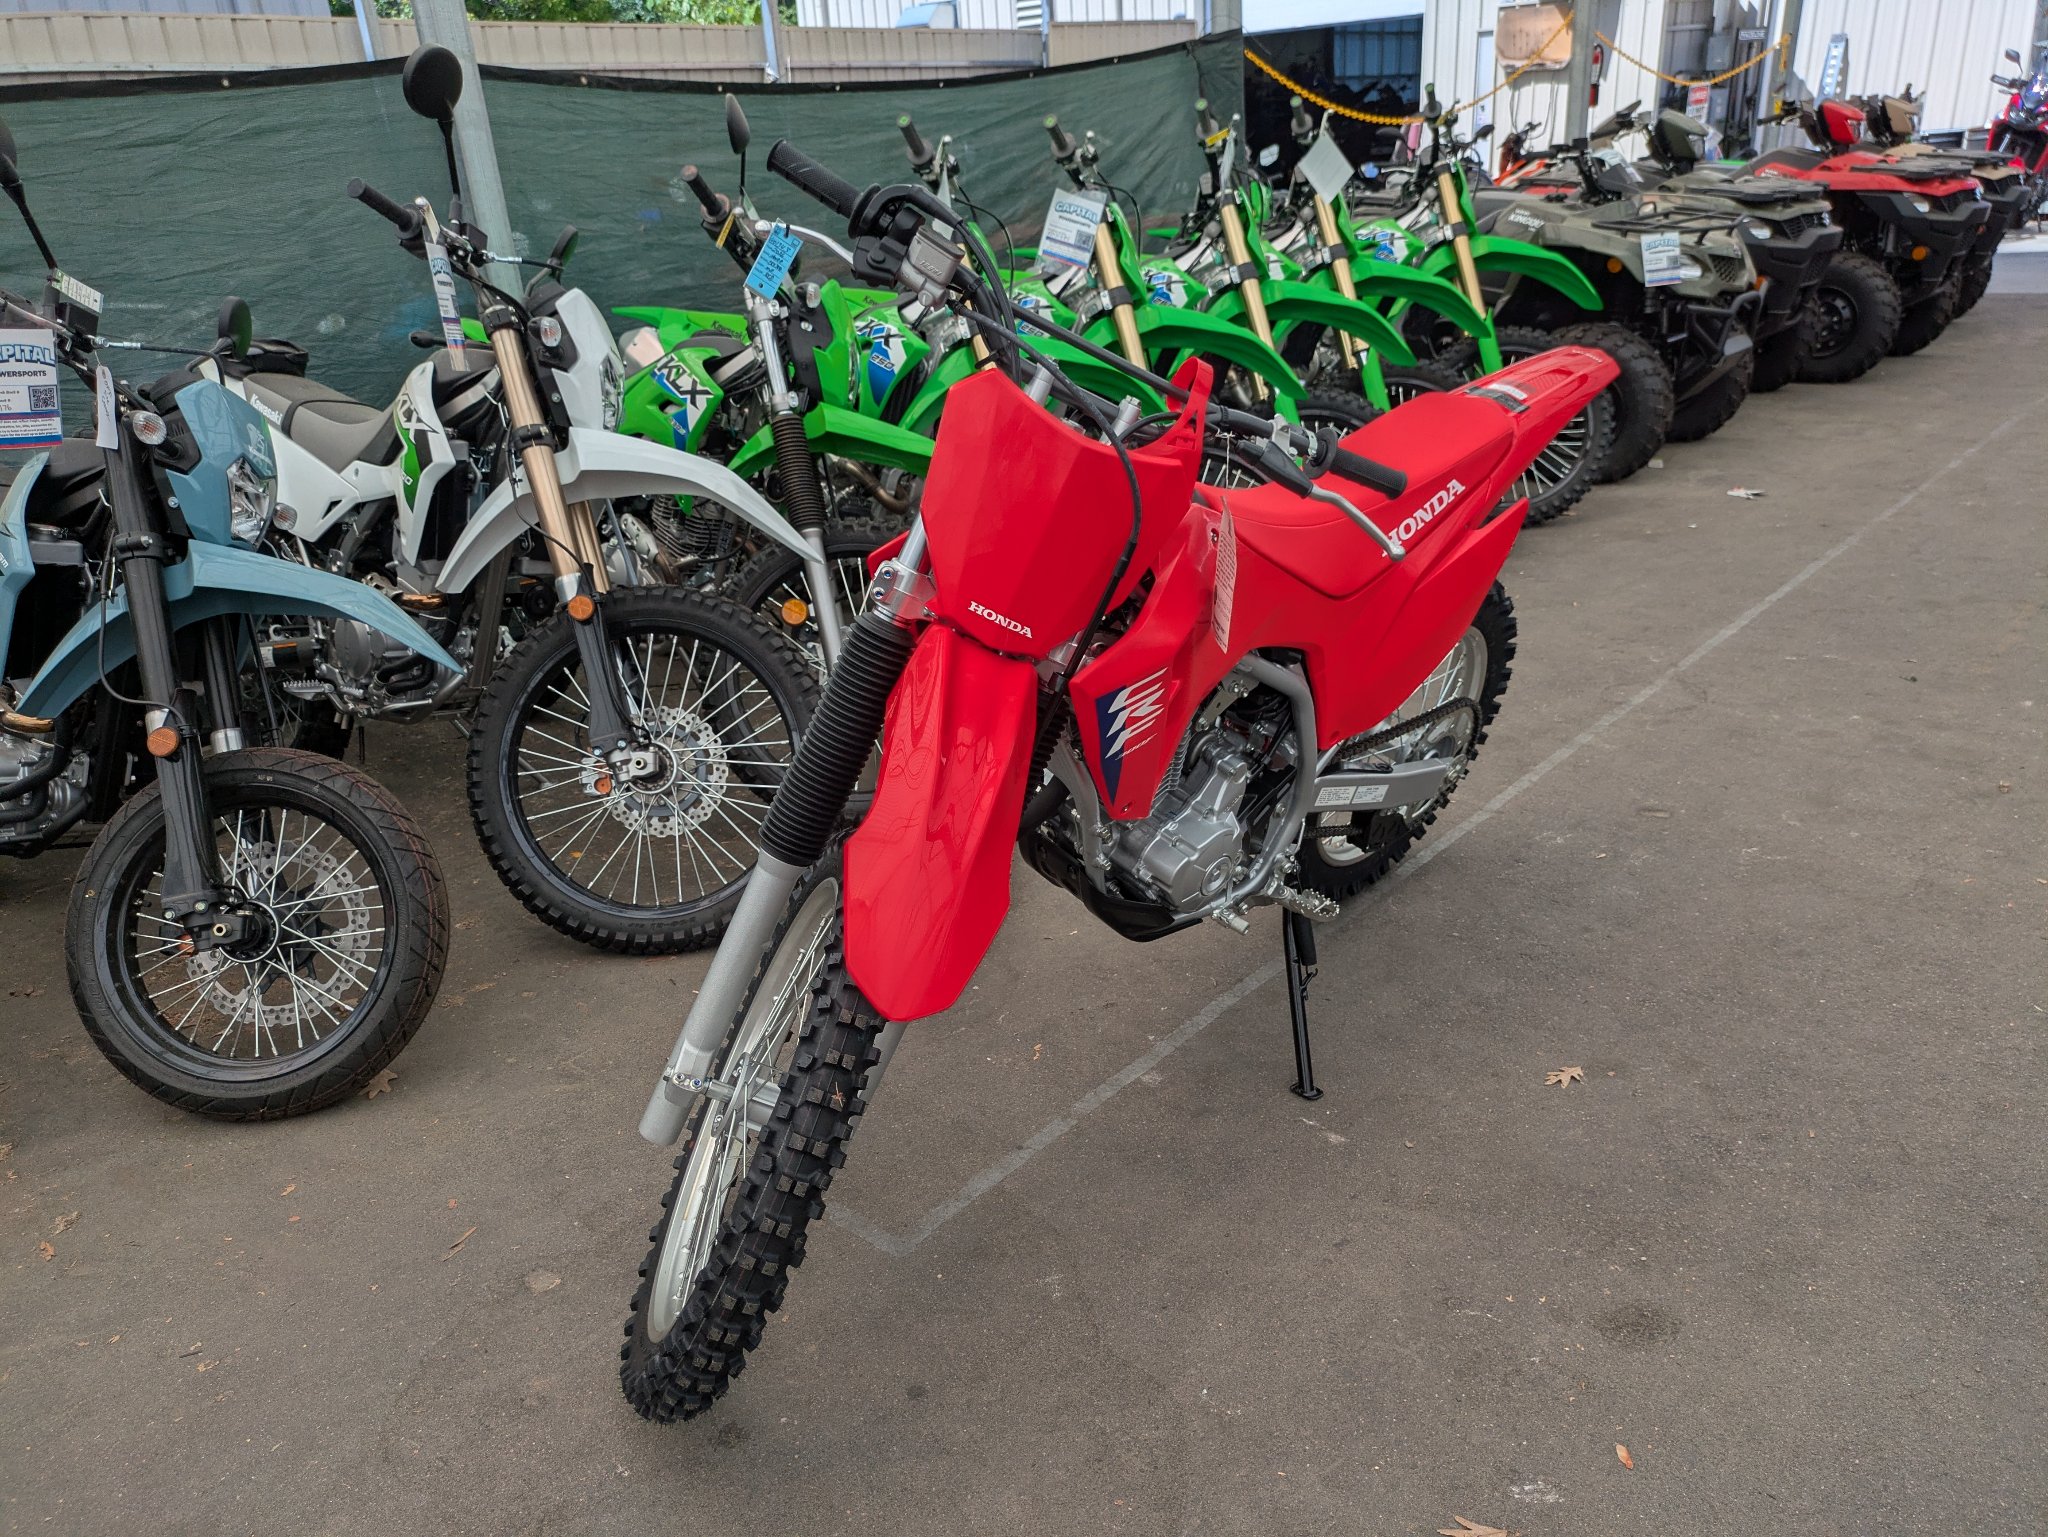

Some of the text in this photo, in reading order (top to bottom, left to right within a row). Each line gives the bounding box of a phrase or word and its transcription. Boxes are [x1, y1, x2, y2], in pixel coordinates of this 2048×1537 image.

[1055, 202, 1099, 225] CAPITAL
[856, 319, 905, 350] KX
[0, 343, 56, 367] PITAL
[871, 354, 895, 370] 250
[656, 354, 715, 411] KLX
[250, 393, 283, 426] Kawasaki
[968, 600, 1033, 639] HONDA
[1105, 666, 1169, 760] CRF
